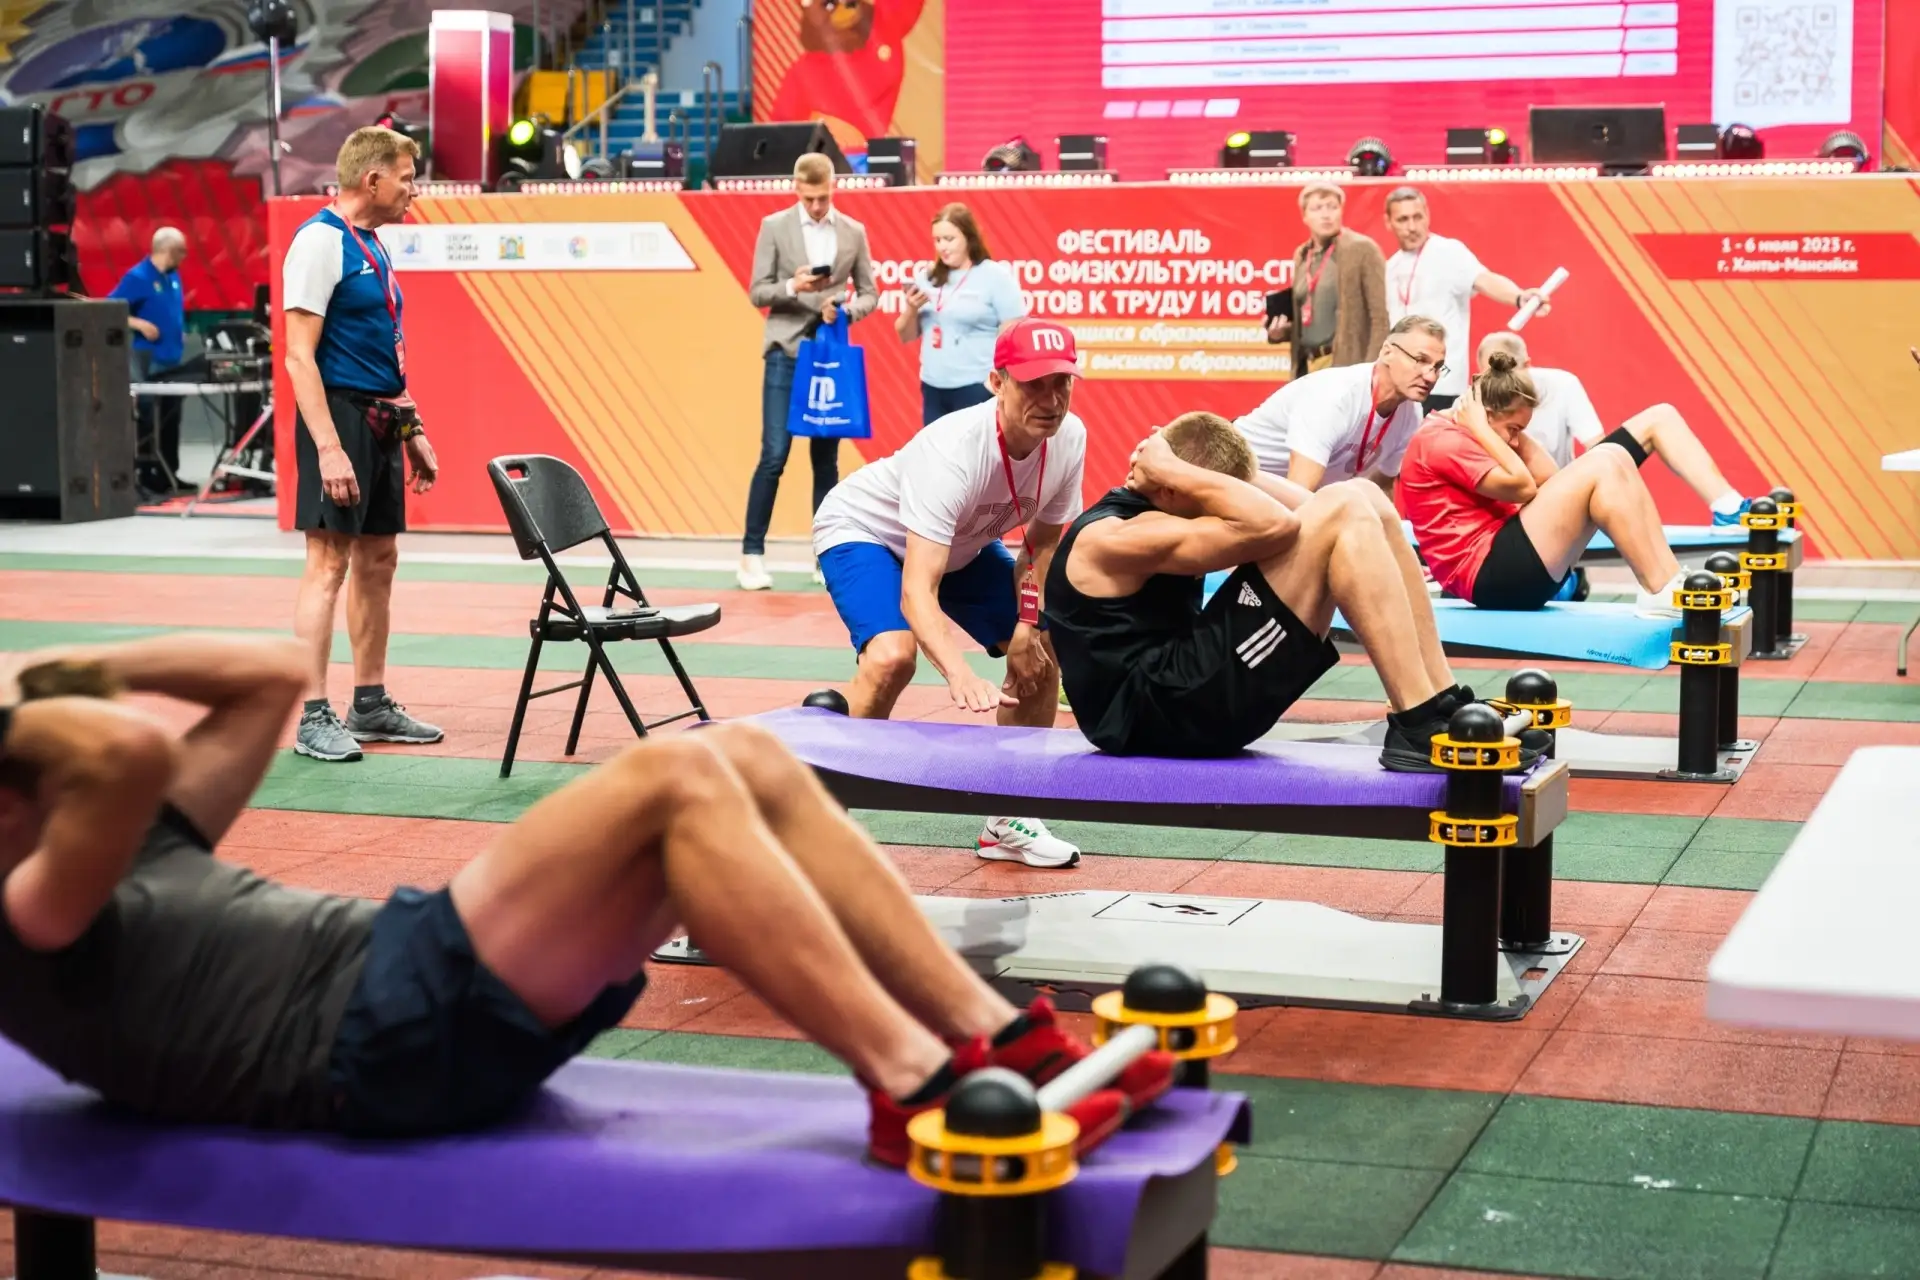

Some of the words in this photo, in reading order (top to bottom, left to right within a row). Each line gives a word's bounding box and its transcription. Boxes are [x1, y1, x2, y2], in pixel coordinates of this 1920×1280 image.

[1057, 228, 1211, 254] ФЕСТИВАЛЬ
[1721, 237, 1731, 253] 1
[1744, 237, 1756, 253] 6
[1048, 259, 1295, 284] ФИЗКУЛЬТУРНО-СП
[1019, 289, 1084, 315] ОТОВ
[1089, 289, 1107, 315] К
[1112, 289, 1196, 317] ТРУДУ
[1202, 289, 1221, 315] И
[1032, 328, 1065, 351] ГТО
